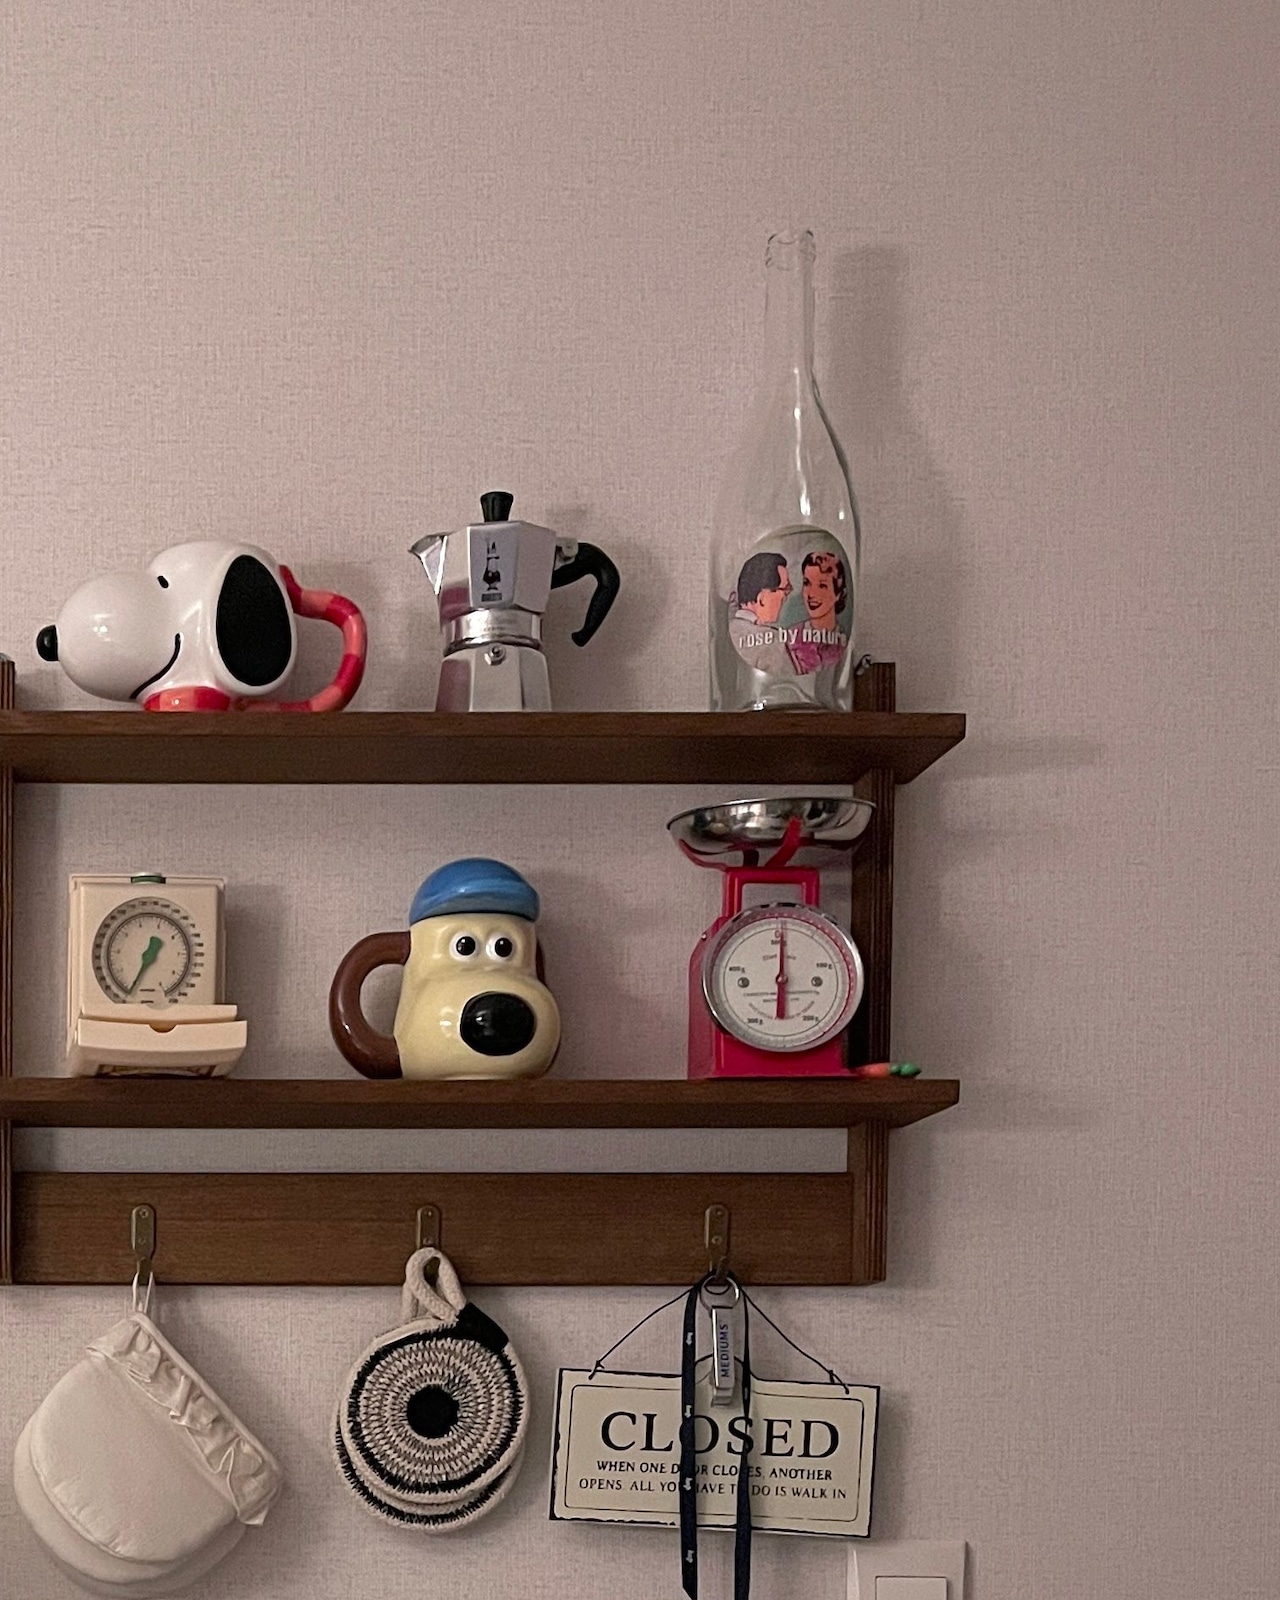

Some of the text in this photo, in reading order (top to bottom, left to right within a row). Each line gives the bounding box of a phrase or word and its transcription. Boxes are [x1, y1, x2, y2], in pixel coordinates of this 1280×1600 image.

[778, 627, 798, 645] by
[719, 1323, 730, 1379] MEDIUMS
[601, 1411, 839, 1458] CLOSED
[597, 1461, 832, 1480] WHEN ONE DR CLOES, ANOTHER
[579, 1478, 622, 1491] OPENS
[630, 1481, 655, 1492] ALL
[752, 1485, 771, 1496] DO
[775, 1486, 787, 1497] IS
[791, 1487, 827, 1499] WALK
[832, 1489, 847, 1499] IN
